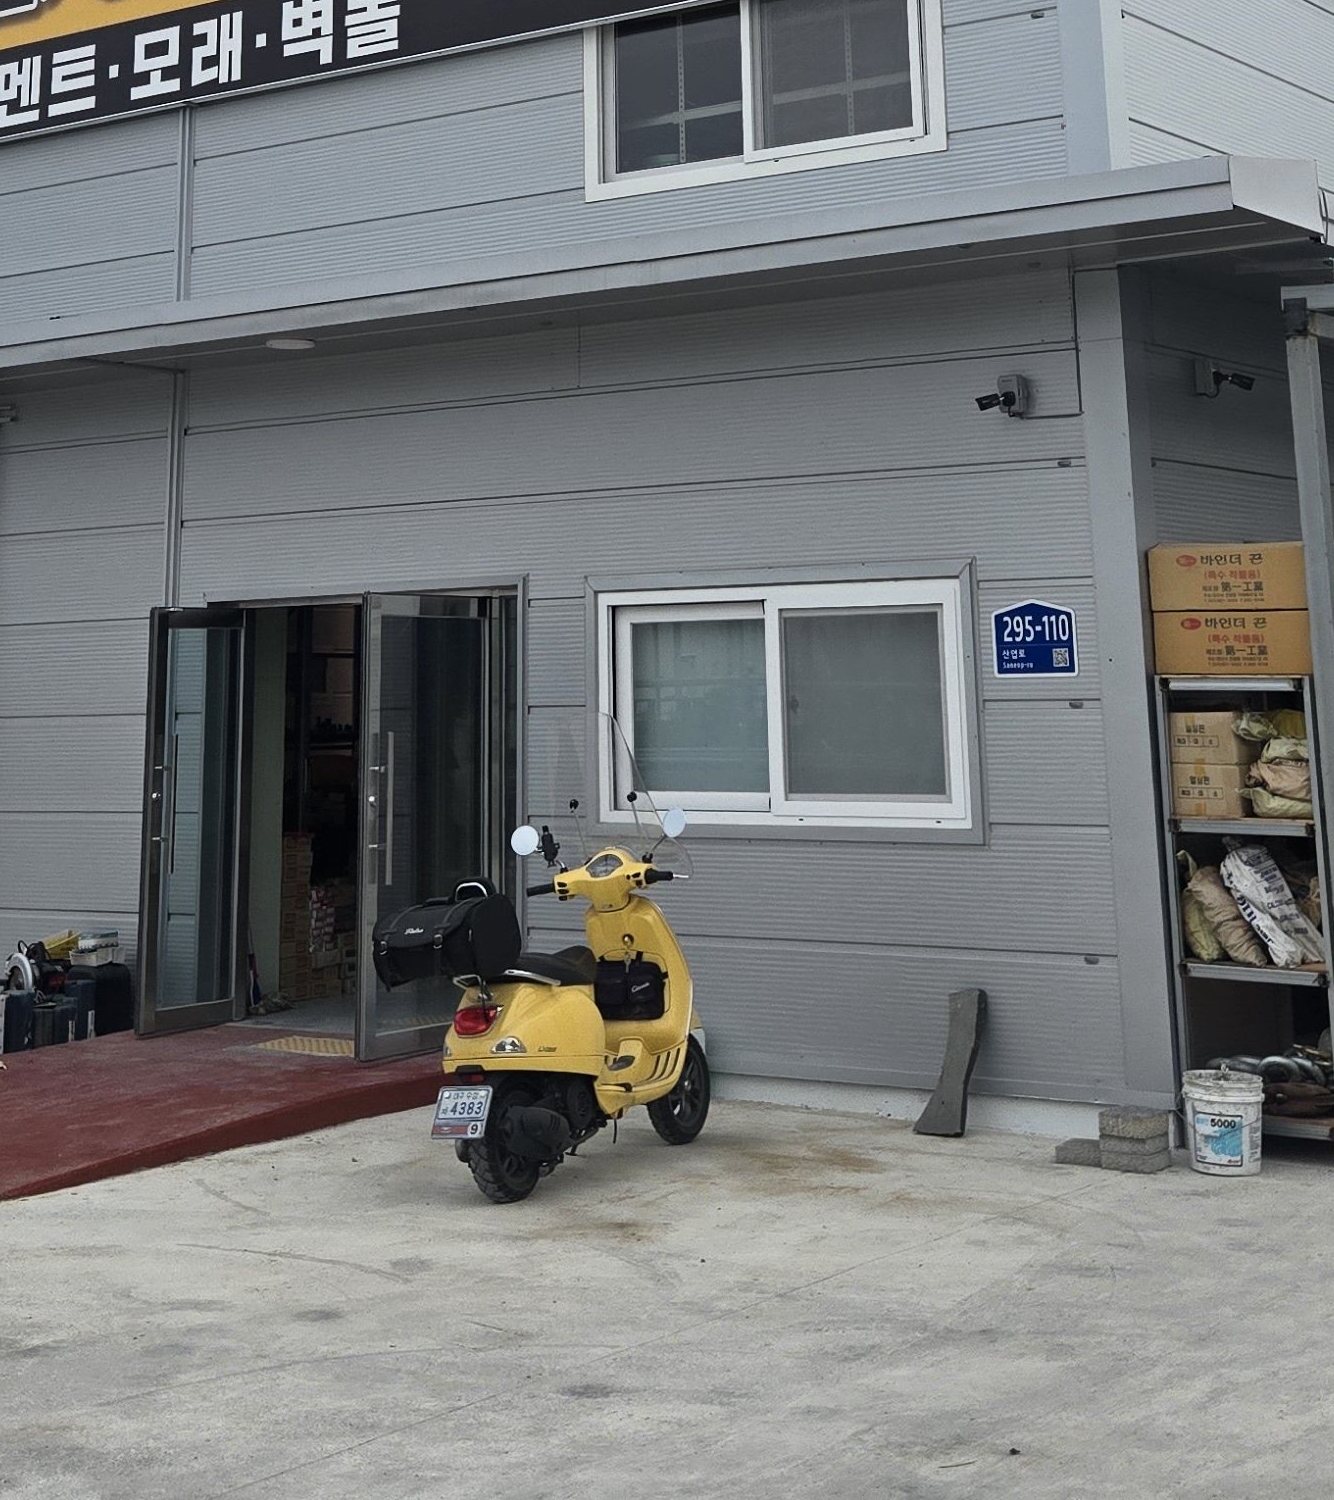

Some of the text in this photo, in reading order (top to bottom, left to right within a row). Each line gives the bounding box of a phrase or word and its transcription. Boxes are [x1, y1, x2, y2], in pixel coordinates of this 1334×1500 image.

[1200, 553, 1242, 566] 바인더
[1002, 614, 1069, 642] 295-110
[1204, 617, 1246, 629] 바인더
[1002, 648, 1026, 660] 산업로
[1002, 661, 1034, 670] Saneop-ro
[449, 1101, 484, 1115] 4383
[1210, 1118, 1237, 1129] 5000
